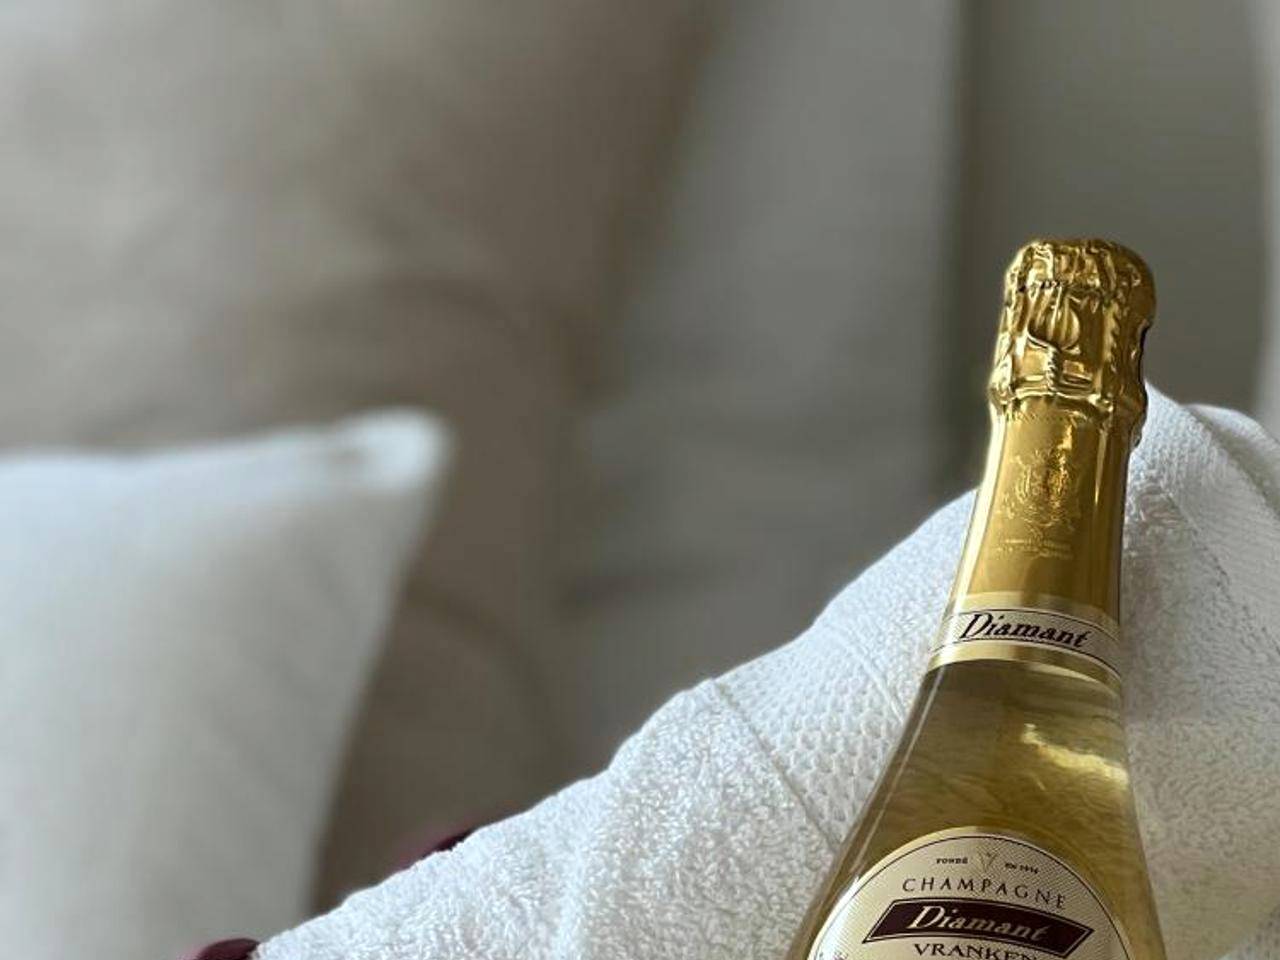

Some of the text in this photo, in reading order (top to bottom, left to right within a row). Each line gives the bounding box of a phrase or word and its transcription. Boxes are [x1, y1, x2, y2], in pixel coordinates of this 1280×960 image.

[960, 613, 1092, 648] Diamant
[902, 878, 1066, 910] CHAMPAGNE
[908, 906, 1049, 942] Diamant
